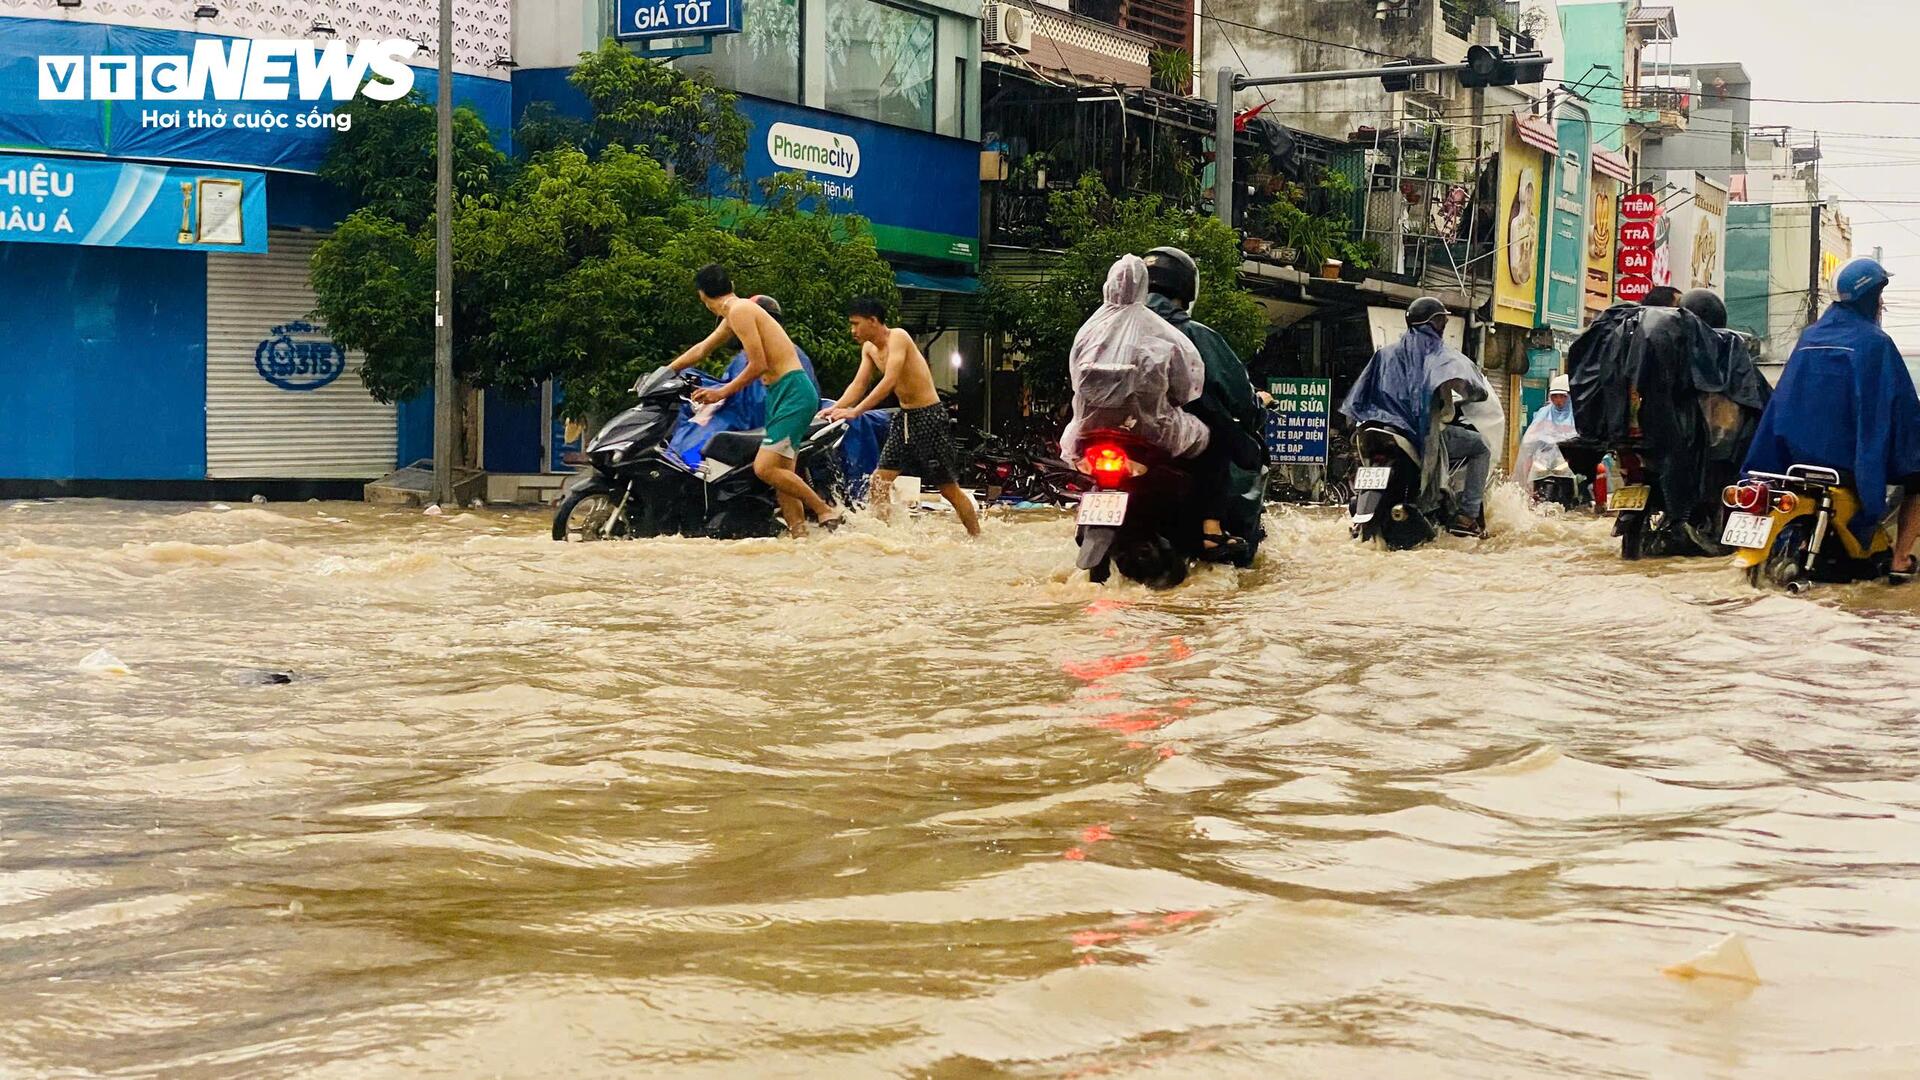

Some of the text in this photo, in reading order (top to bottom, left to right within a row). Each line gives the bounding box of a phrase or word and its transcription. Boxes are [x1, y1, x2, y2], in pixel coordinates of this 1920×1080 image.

[634, 1, 669, 29] GIÁ
[774, 134, 853, 174] Pharmacity
[1624, 198, 1654, 214] TIỆM
[53, 208, 74, 233] Á
[1624, 226, 1650, 240] TRÀ
[1624, 253, 1647, 267] ĐÀI
[1620, 283, 1649, 294] LOAN
[1271, 381, 1326, 396] MUA BÁN
[1300, 397, 1324, 412] SỬA
[1288, 415, 1306, 427] MÁY
[1276, 430, 1287, 439] XE
[1275, 443, 1287, 453] XE
